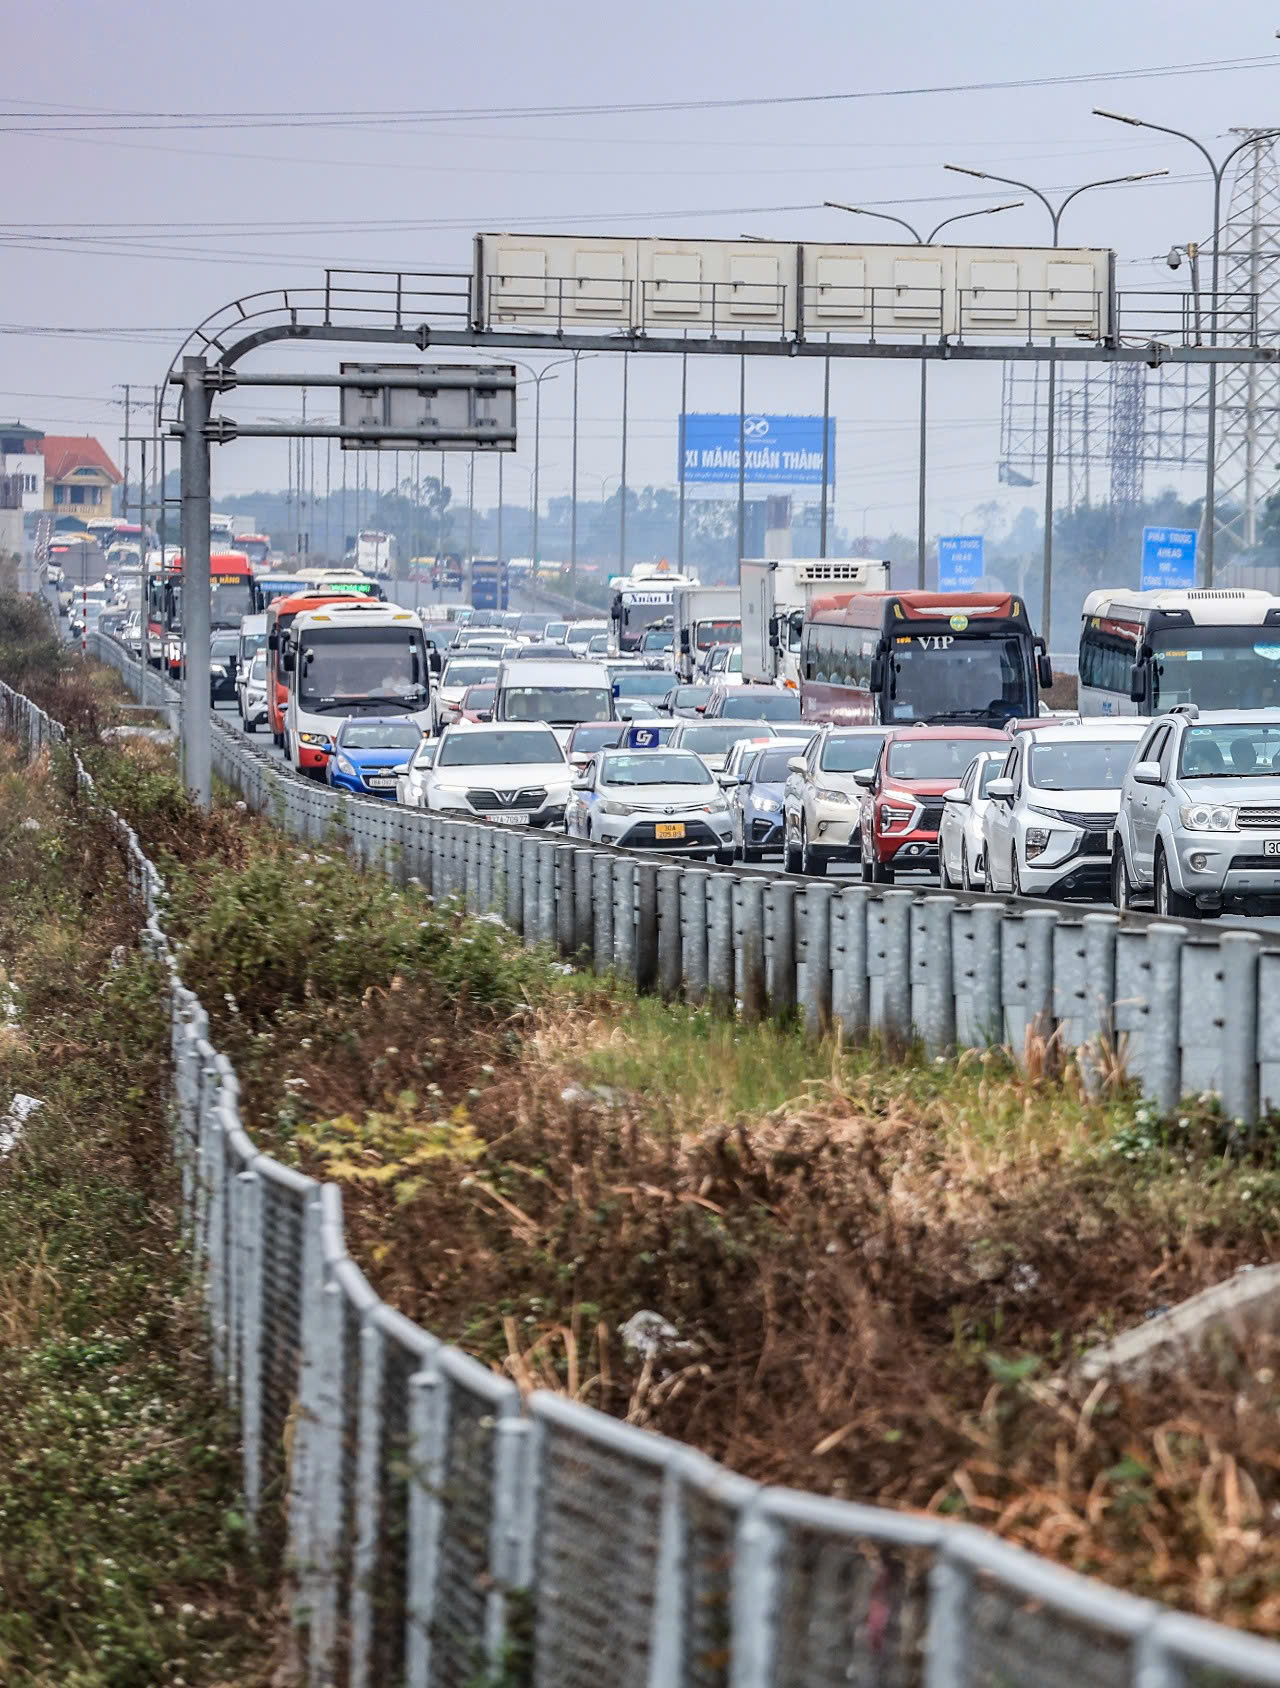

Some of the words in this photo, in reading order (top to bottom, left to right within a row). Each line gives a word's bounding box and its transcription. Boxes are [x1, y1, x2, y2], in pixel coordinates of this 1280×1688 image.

[684, 450, 698, 468] XI
[744, 448, 779, 470] XUÂN
[917, 635, 954, 650] VIP
